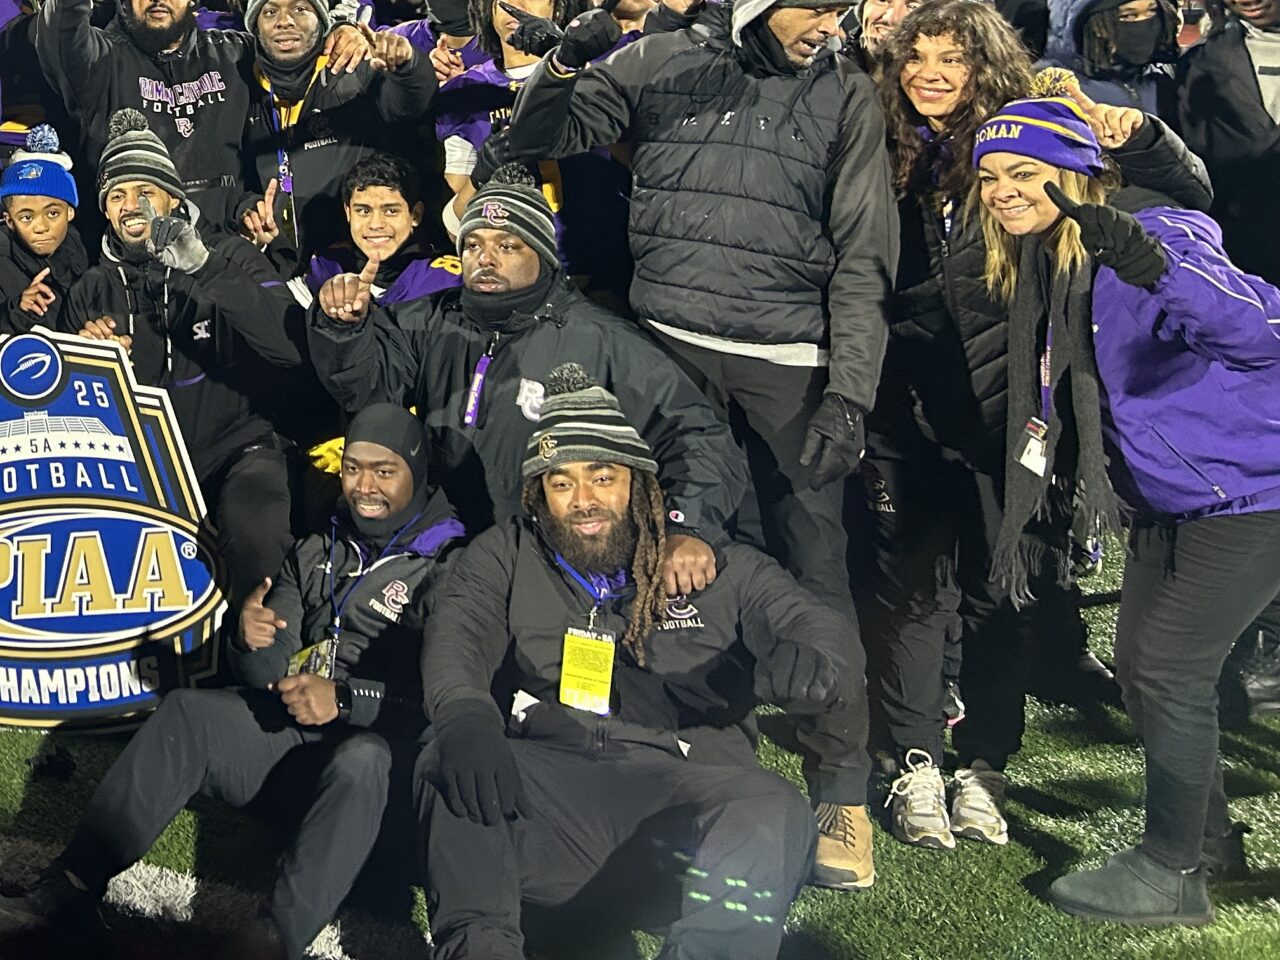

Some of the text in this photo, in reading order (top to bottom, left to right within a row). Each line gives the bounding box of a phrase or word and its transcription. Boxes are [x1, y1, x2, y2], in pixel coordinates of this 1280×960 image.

[173, 71, 226, 106] CATHOLIC
[175, 118, 194, 137] RC
[304, 136, 338, 150] FOOTBALL
[482, 202, 509, 225] RC
[74, 380, 109, 409] 25
[30, 438, 52, 454] 5A
[382, 580, 409, 613] RC
[369, 599, 401, 624] FOOTBALL
[568, 627, 598, 640] FRIDAY
[658, 618, 704, 631] OOTBALL
